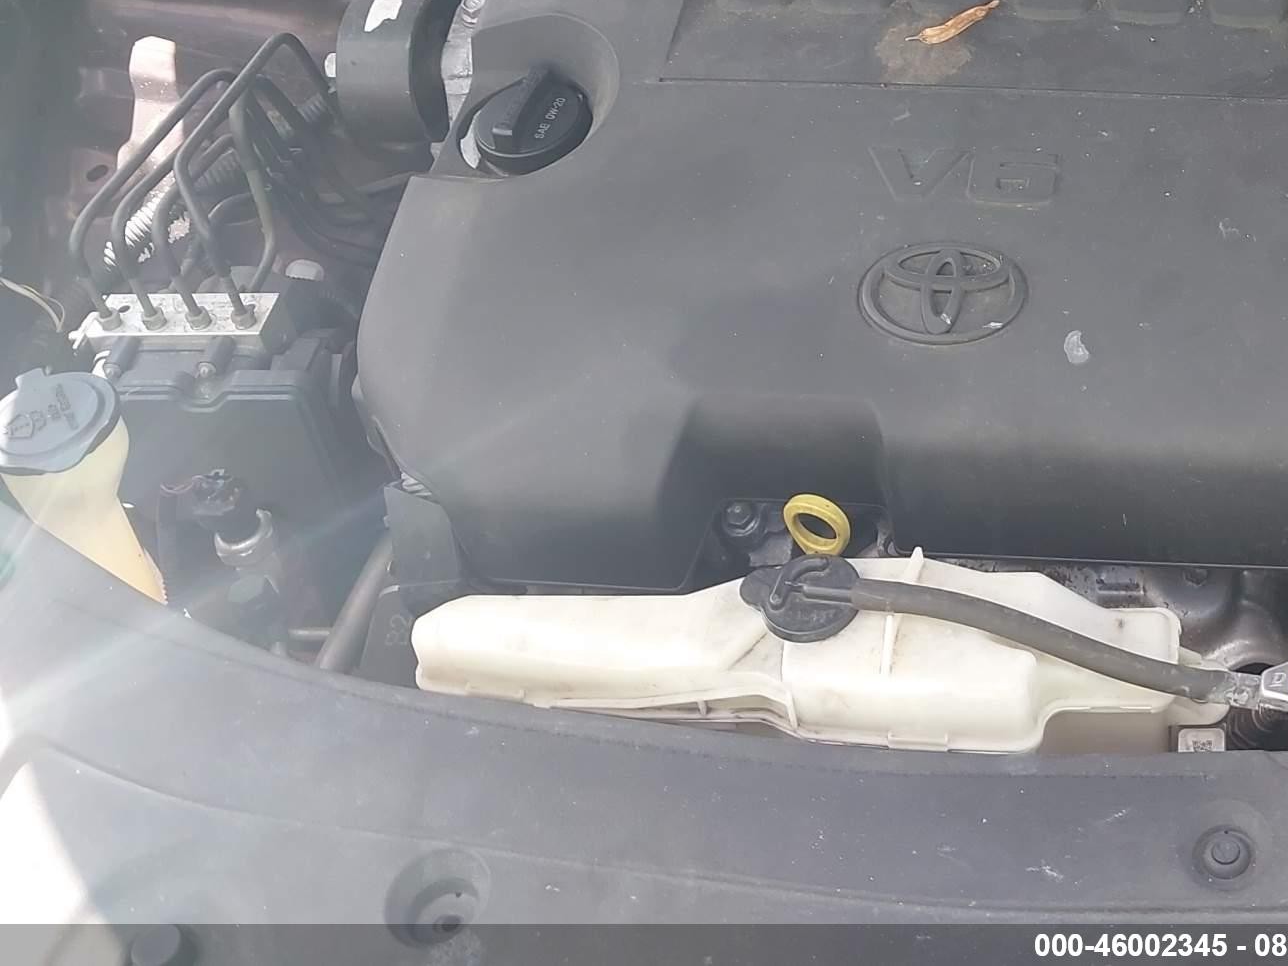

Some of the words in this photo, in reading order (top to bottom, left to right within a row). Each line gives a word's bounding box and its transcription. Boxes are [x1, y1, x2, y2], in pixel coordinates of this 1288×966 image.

[534, 123, 550, 139] SAE
[545, 97, 566, 121] 0W-20
[866, 146, 1061, 205] V6
